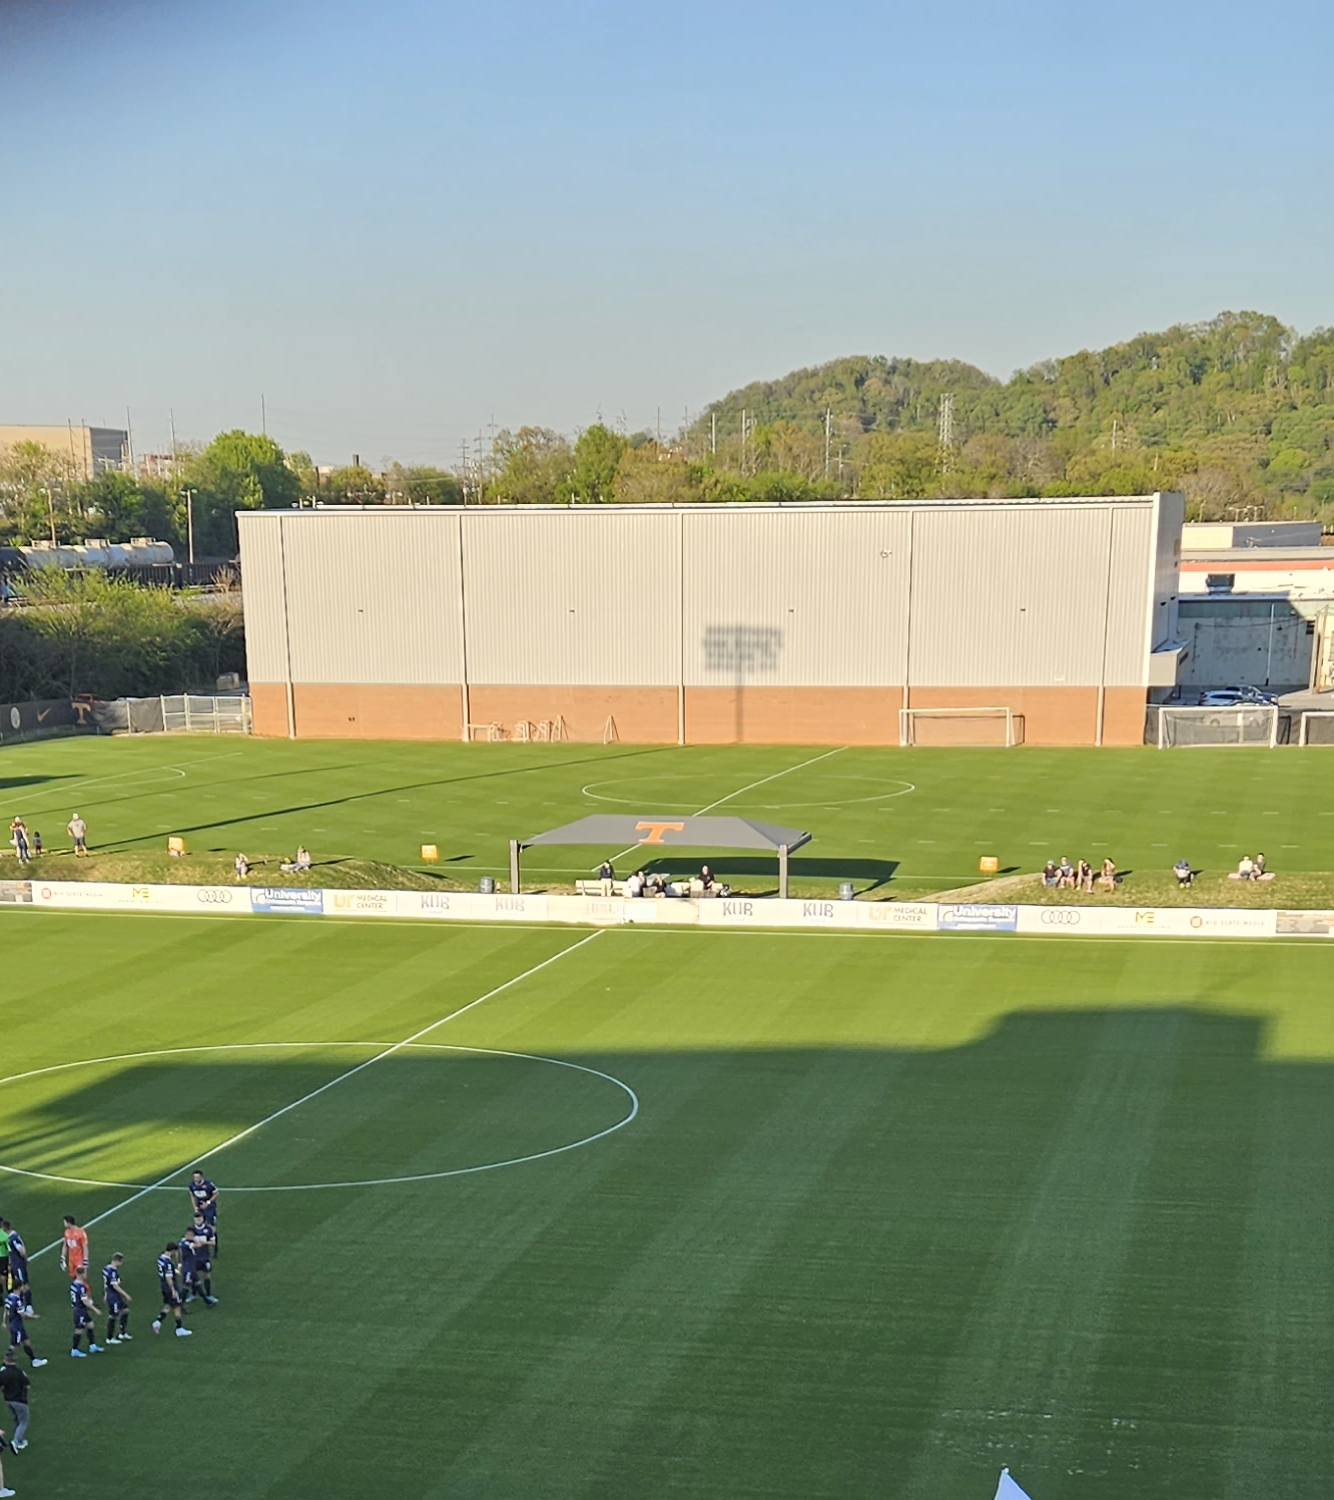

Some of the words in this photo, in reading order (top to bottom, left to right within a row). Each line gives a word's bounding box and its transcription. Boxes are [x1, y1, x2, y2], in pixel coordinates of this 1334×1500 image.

[635, 821, 684, 844] T
[266, 888, 322, 901] University
[356, 894, 387, 903] MEDICAL
[356, 902, 383, 910] CENTER
[421, 894, 450, 910] KUB
[496, 896, 524, 912] KUB
[723, 902, 753, 917] KUB
[803, 902, 833, 918] KUB
[893, 907, 928, 915] MEDICAL
[953, 905, 1017, 919] University
[893, 915, 922, 923] CENTER
